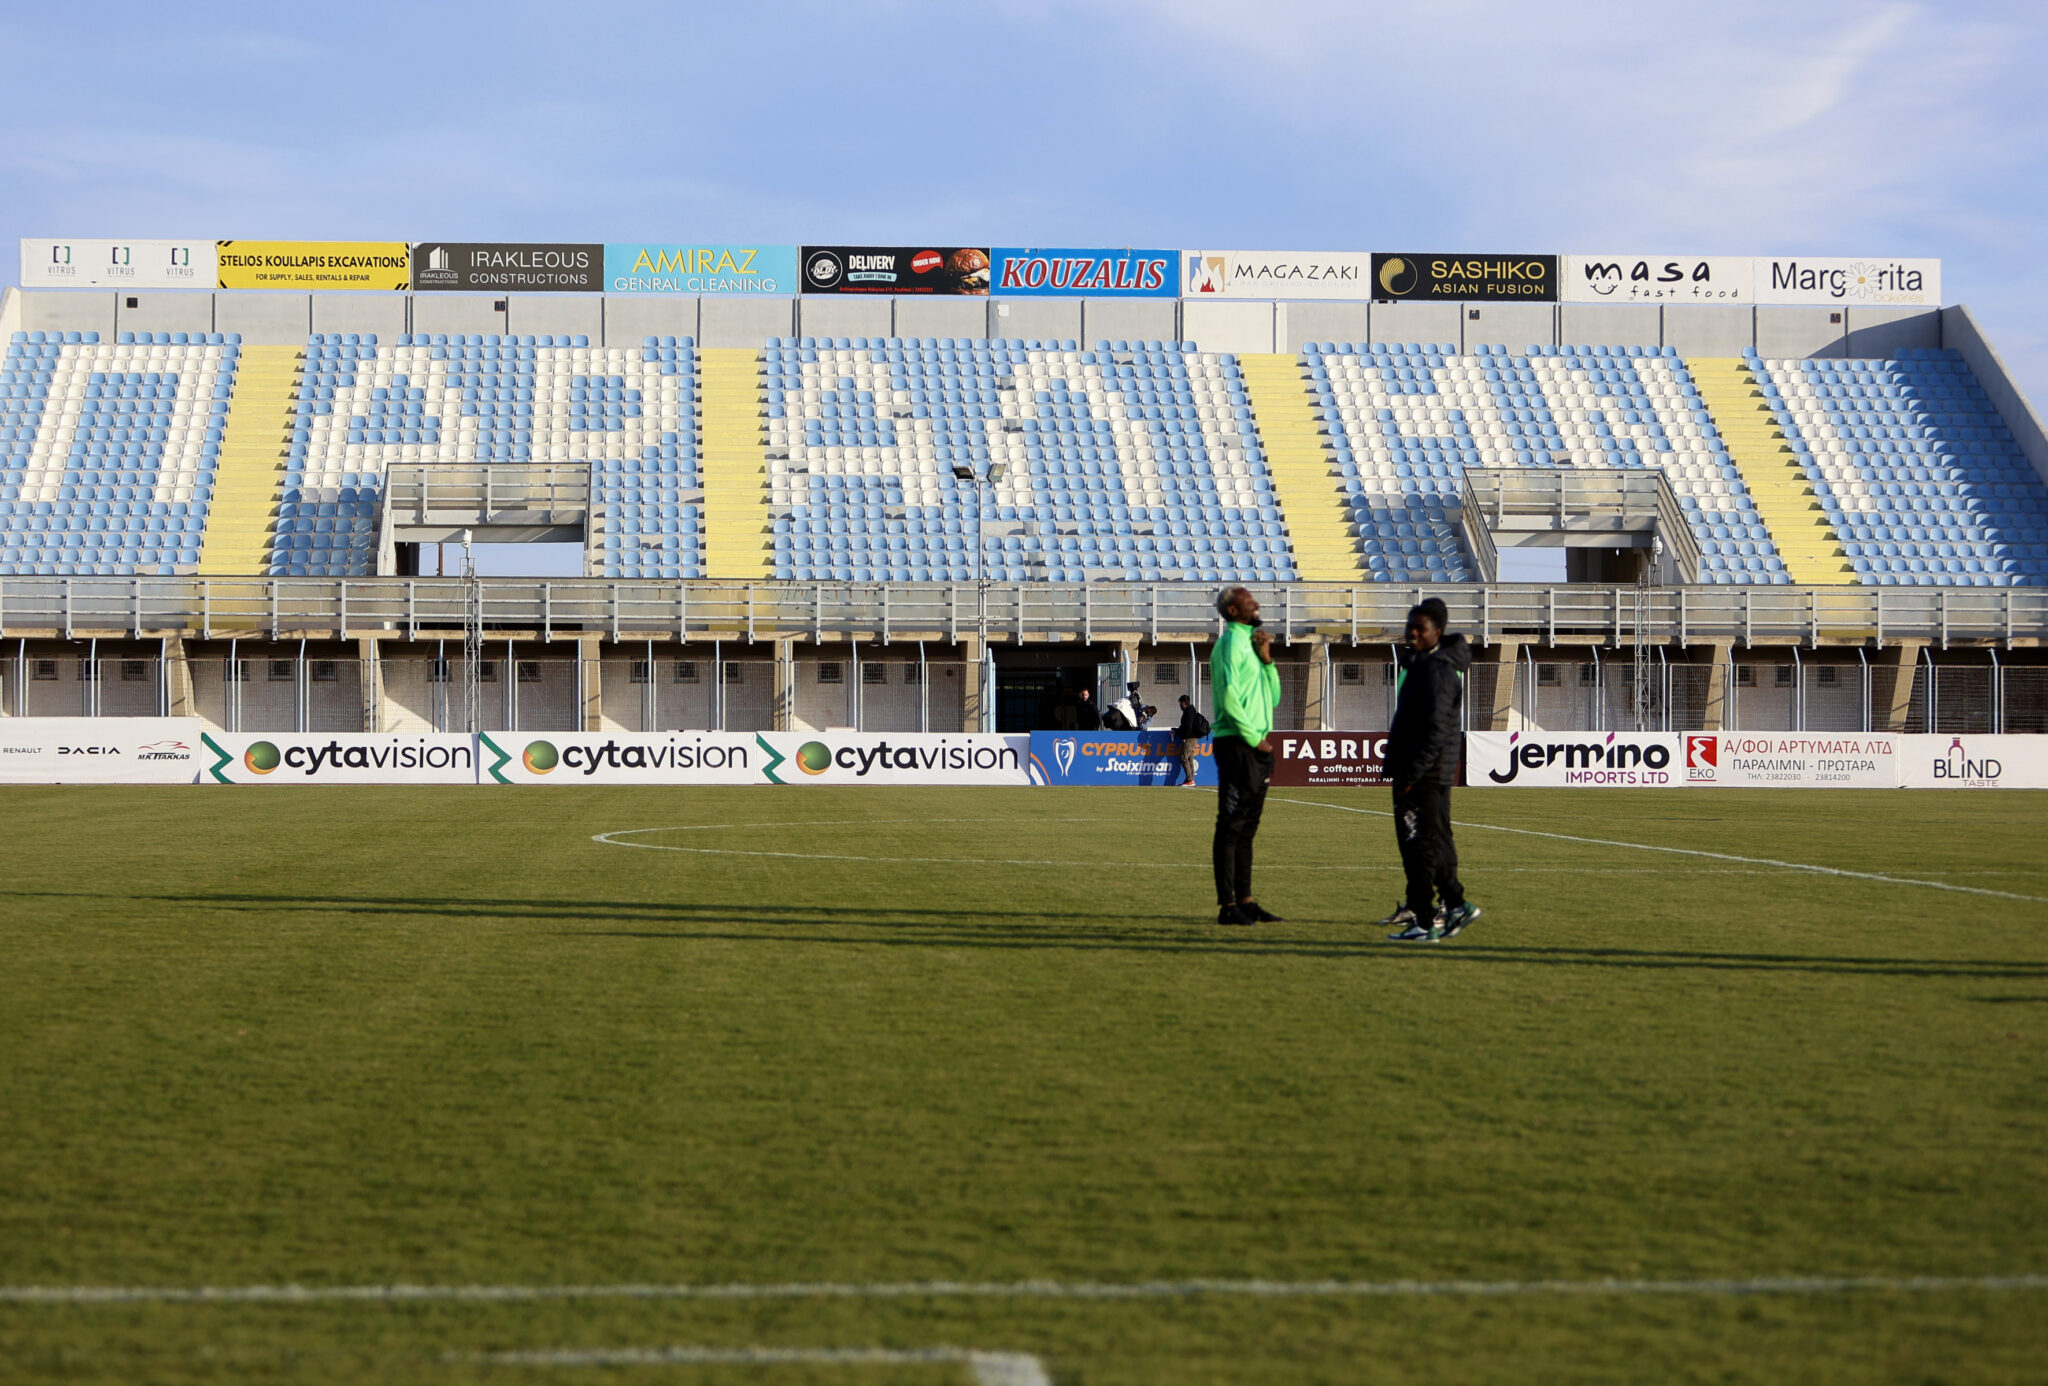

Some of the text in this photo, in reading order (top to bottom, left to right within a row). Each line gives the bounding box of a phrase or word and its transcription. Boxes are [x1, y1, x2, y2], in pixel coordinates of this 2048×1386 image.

[220, 255, 406, 268] STELIOS KOULLAPIS EXCAVATIONS
[471, 251, 589, 268] IRAKLEOUS
[632, 248, 759, 274] AMIRAZ
[849, 255, 896, 271] DELIVERY
[47, 266, 76, 275] VITRUS
[107, 266, 135, 275] VITRUS
[166, 268, 194, 276] VITRUS
[256, 273, 268, 281] FOR
[294, 274, 314, 282] SALES,
[1000, 257, 1166, 290] KOUZALIS
[1234, 263, 1358, 280] MAGAZAKI
[1431, 260, 1545, 280] SASHIKO
[1584, 261, 1710, 282] masa
[469, 273, 588, 284] CONSTRUCTIONS
[614, 277, 777, 292] GENRAL CLEANING
[1432, 284, 1544, 295] ASIAN FUSION
[1630, 285, 1738, 298] fast food
[58, 746, 121, 755] DACIA
[1081, 742, 1214, 757] CYPRUS LEAGU
[1282, 739, 1389, 759] FABRIC
[1723, 738, 1892, 755] Α/ΦΟΙ ΑΡΤΥΜΑΤΑ ΛΤΔ
[284, 738, 471, 775] cytavision
[562, 737, 747, 775] cytavision
[835, 738, 1018, 776] cytavision
[1488, 731, 1670, 784] jermino
[1105, 757, 1173, 772] Stoiximan
[1323, 764, 1354, 773] coffee
[1732, 759, 1806, 771] ΠΑΡΑΛΙΜΝΙ
[1817, 759, 1875, 771] ΠΡΩΤΑΡΑ
[1565, 771, 1669, 784] IMPORTS LTD
[1766, 773, 1801, 781] 23822030
[1962, 779, 2000, 787] TASTE
